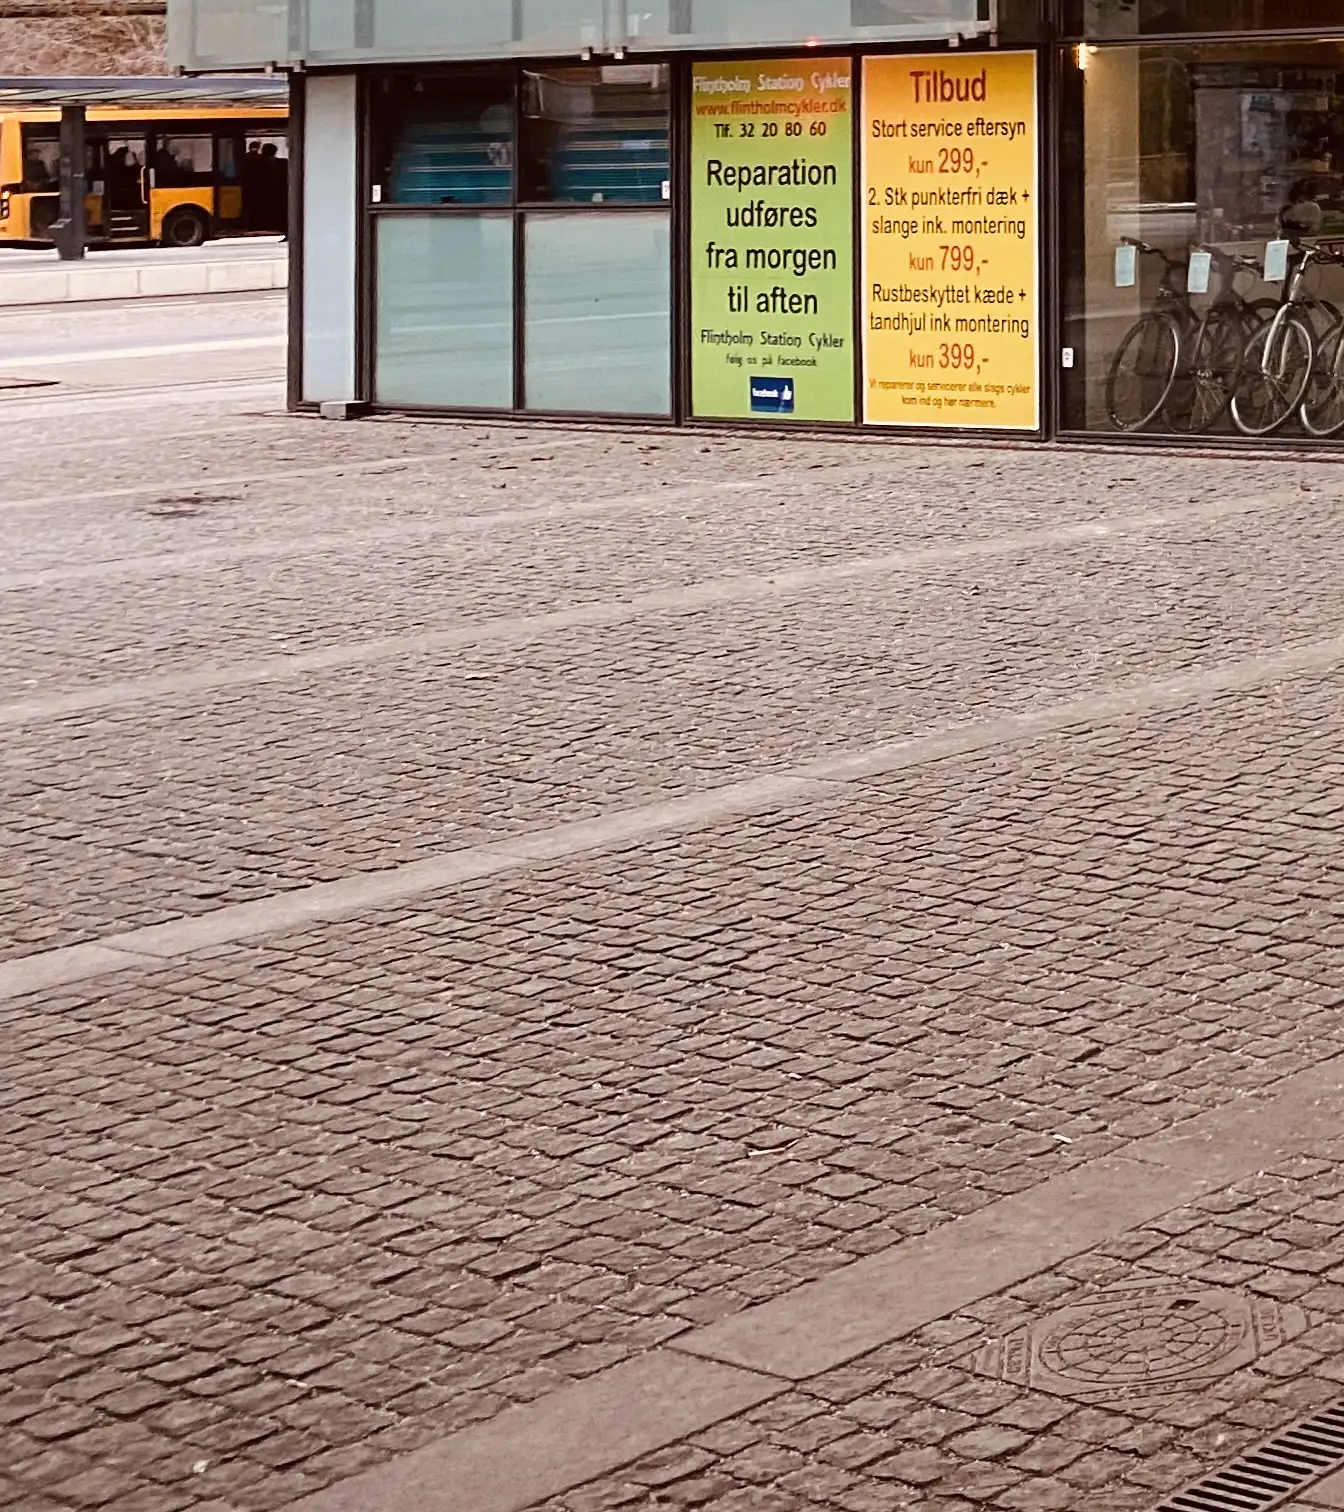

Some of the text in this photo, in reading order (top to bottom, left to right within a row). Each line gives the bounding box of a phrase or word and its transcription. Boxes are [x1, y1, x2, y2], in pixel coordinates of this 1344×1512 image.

[757, 73, 804, 92] Station
[909, 68, 986, 103] Tilbud
[695, 98, 847, 118] www.flintholmcykler.dk
[714, 121, 826, 138] Tlf. 32 20 80 60
[872, 117, 1025, 141] Stort service eftersyn
[707, 158, 837, 192] Reparation
[908, 148, 988, 178] kun 299,-
[868, 186, 1030, 210] 2. Stk punkterfri dæk +
[727, 200, 817, 228] udføres
[872, 216, 1025, 239] slange ink. montering
[705, 242, 837, 276] fra morgen
[909, 245, 989, 275] kun 799,-
[727, 286, 818, 314] til aften
[872, 284, 1027, 308] Rustbeskyttet kæde +
[870, 312, 1029, 338] tandhjul ink montering
[700, 329, 845, 352] Flintholm Station Cykler
[777, 354, 817, 368] facebook
[909, 343, 989, 375] kun 399,-
